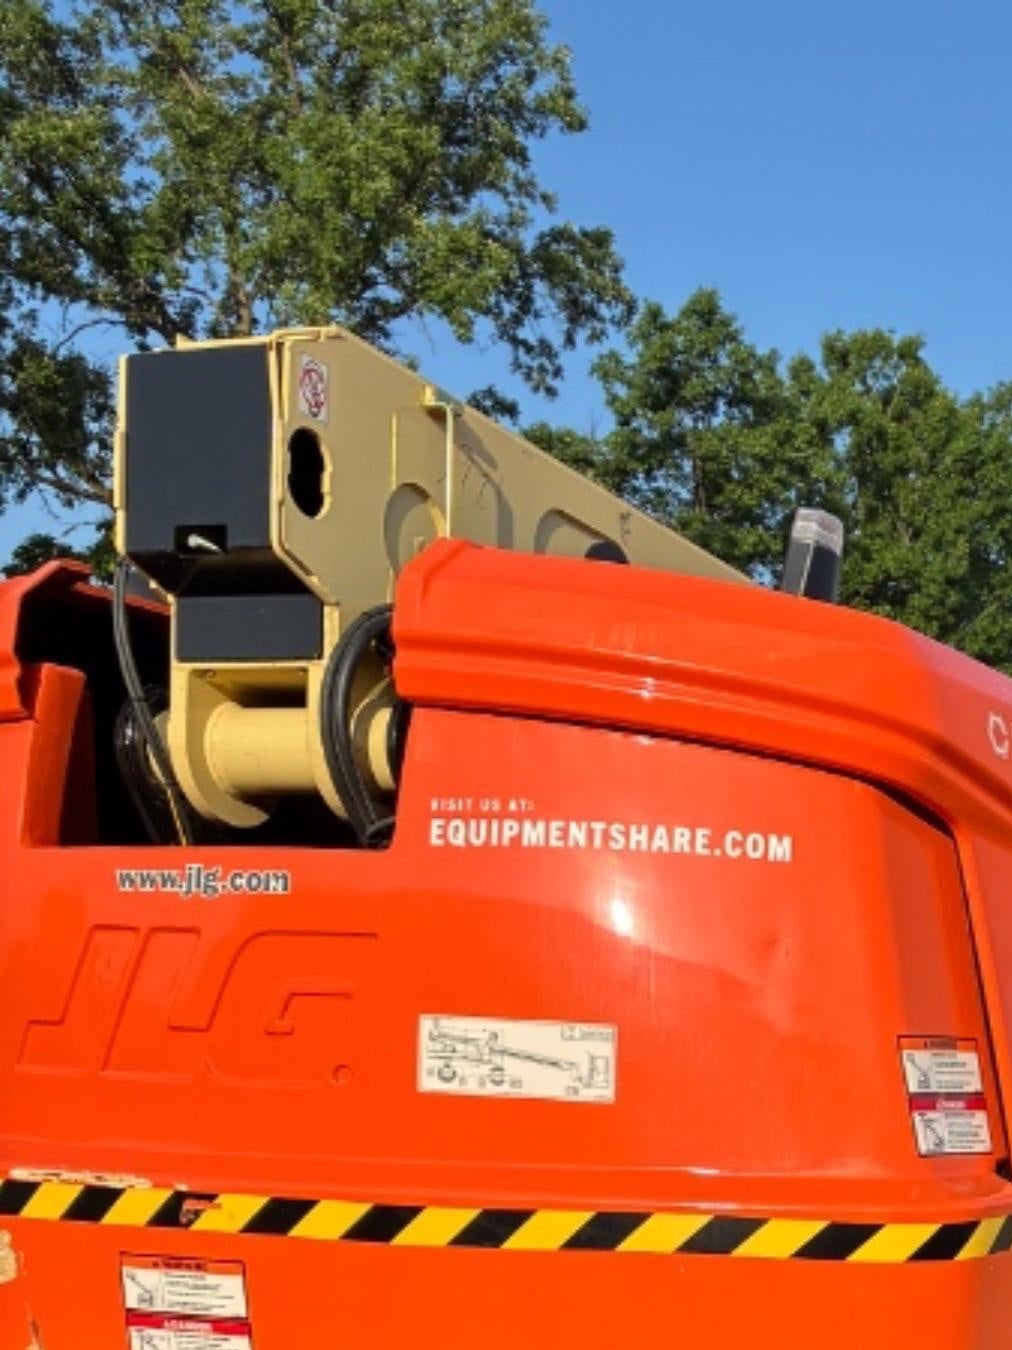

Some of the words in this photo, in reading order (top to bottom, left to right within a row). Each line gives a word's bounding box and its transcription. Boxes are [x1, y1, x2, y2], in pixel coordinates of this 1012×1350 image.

[480, 797, 502, 812] US
[429, 817, 794, 863] EQUIPMENTSHARE.COM
[115, 863, 292, 898] www.jlg.com
